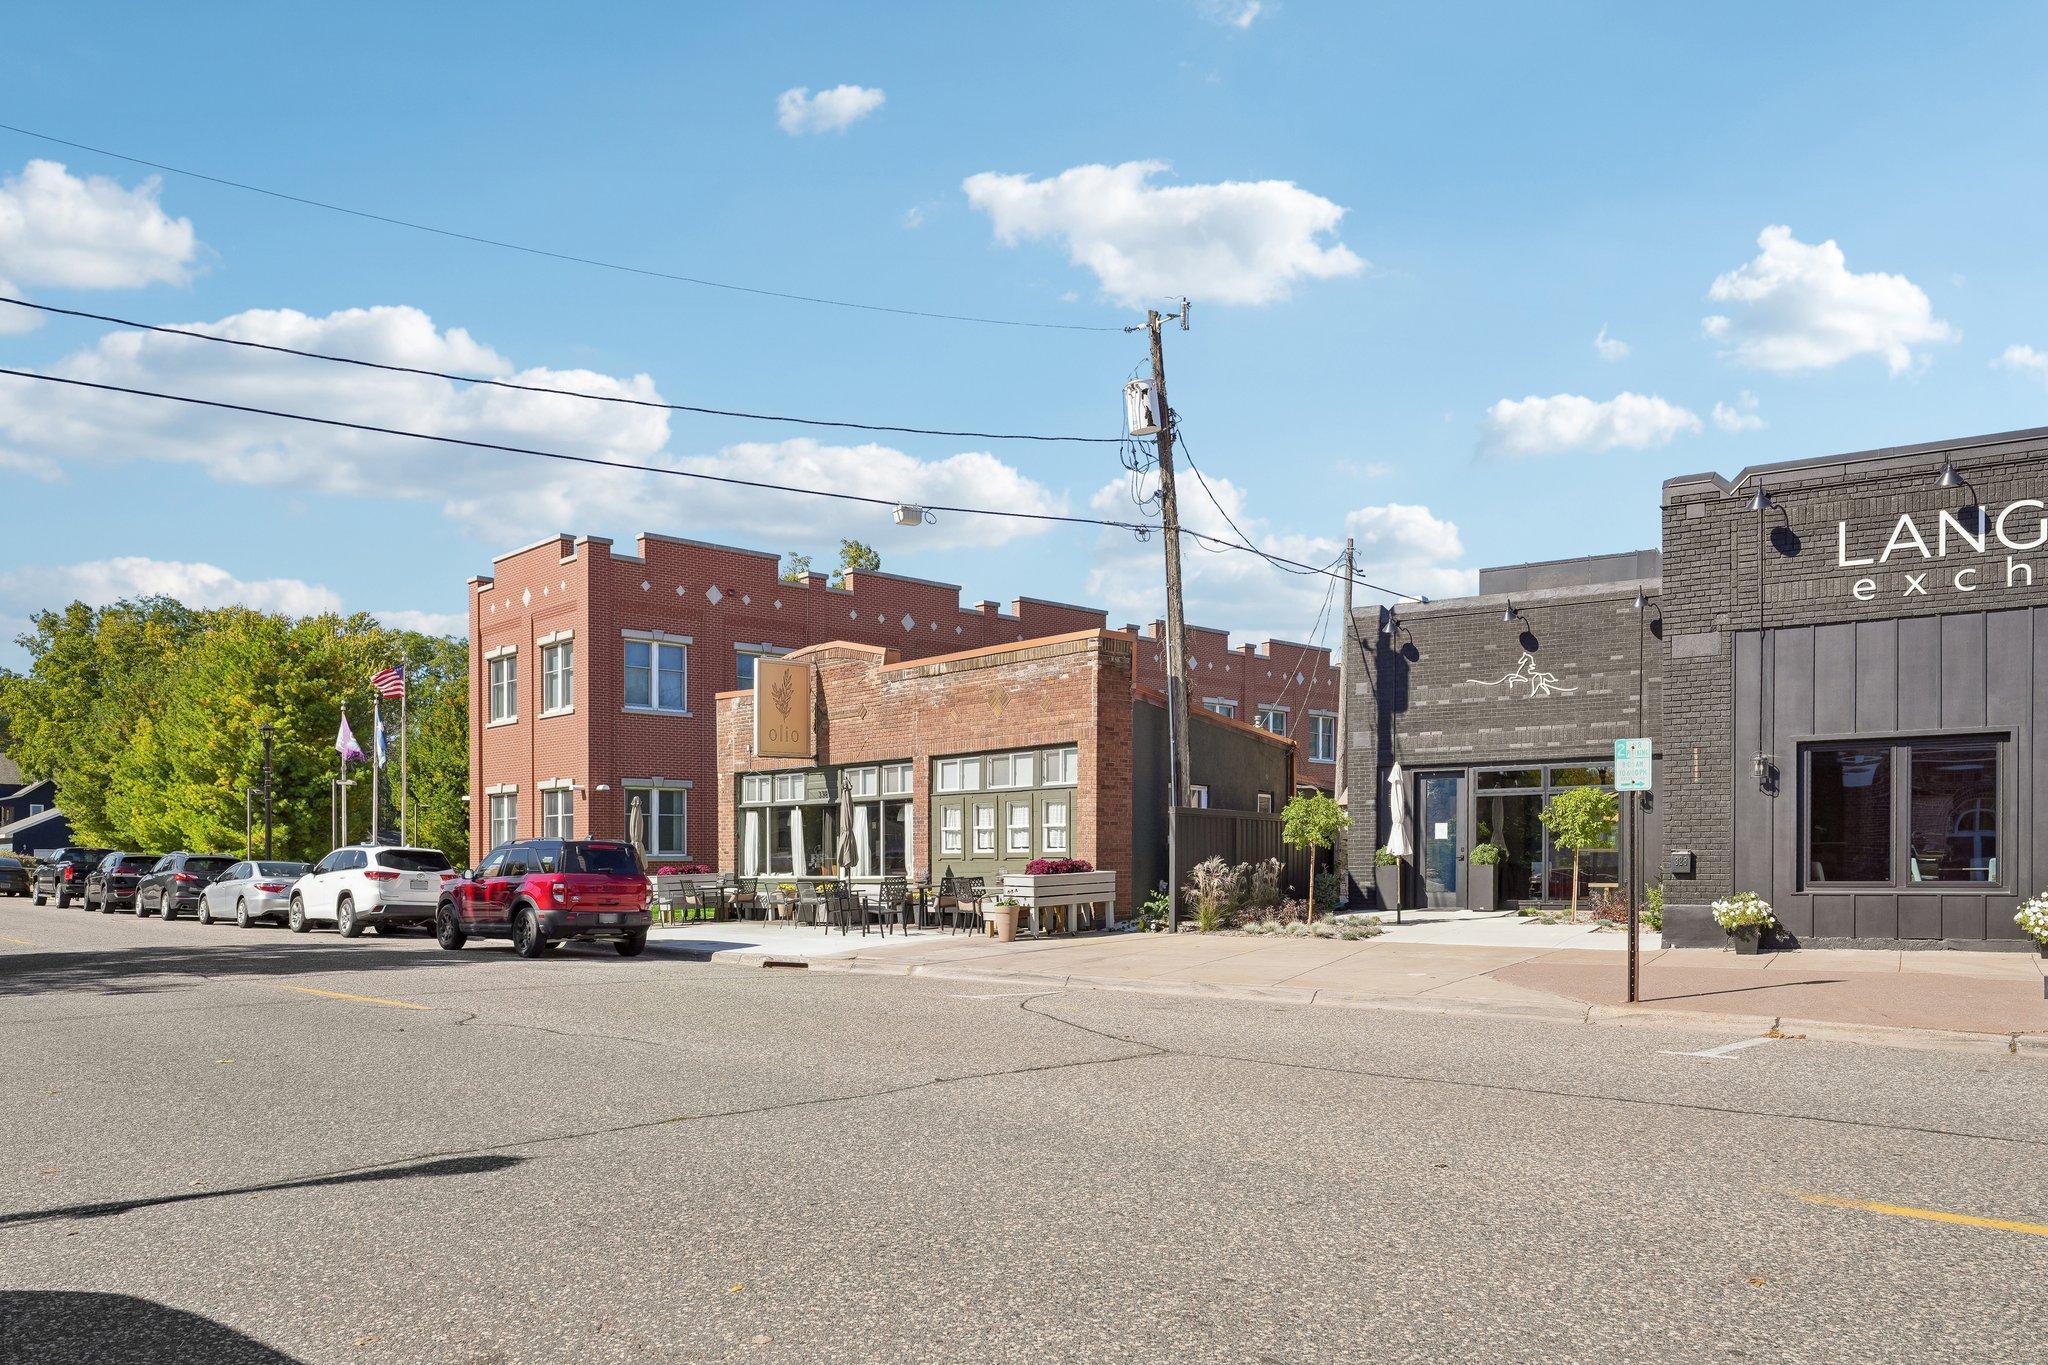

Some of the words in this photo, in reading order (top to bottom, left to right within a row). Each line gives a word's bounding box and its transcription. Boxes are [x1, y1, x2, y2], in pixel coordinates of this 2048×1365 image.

[1839, 500, 2048, 567] LANG
[1853, 556, 2032, 600] exch
[769, 725, 799, 742] olio
[1617, 743, 1626, 756] 2
